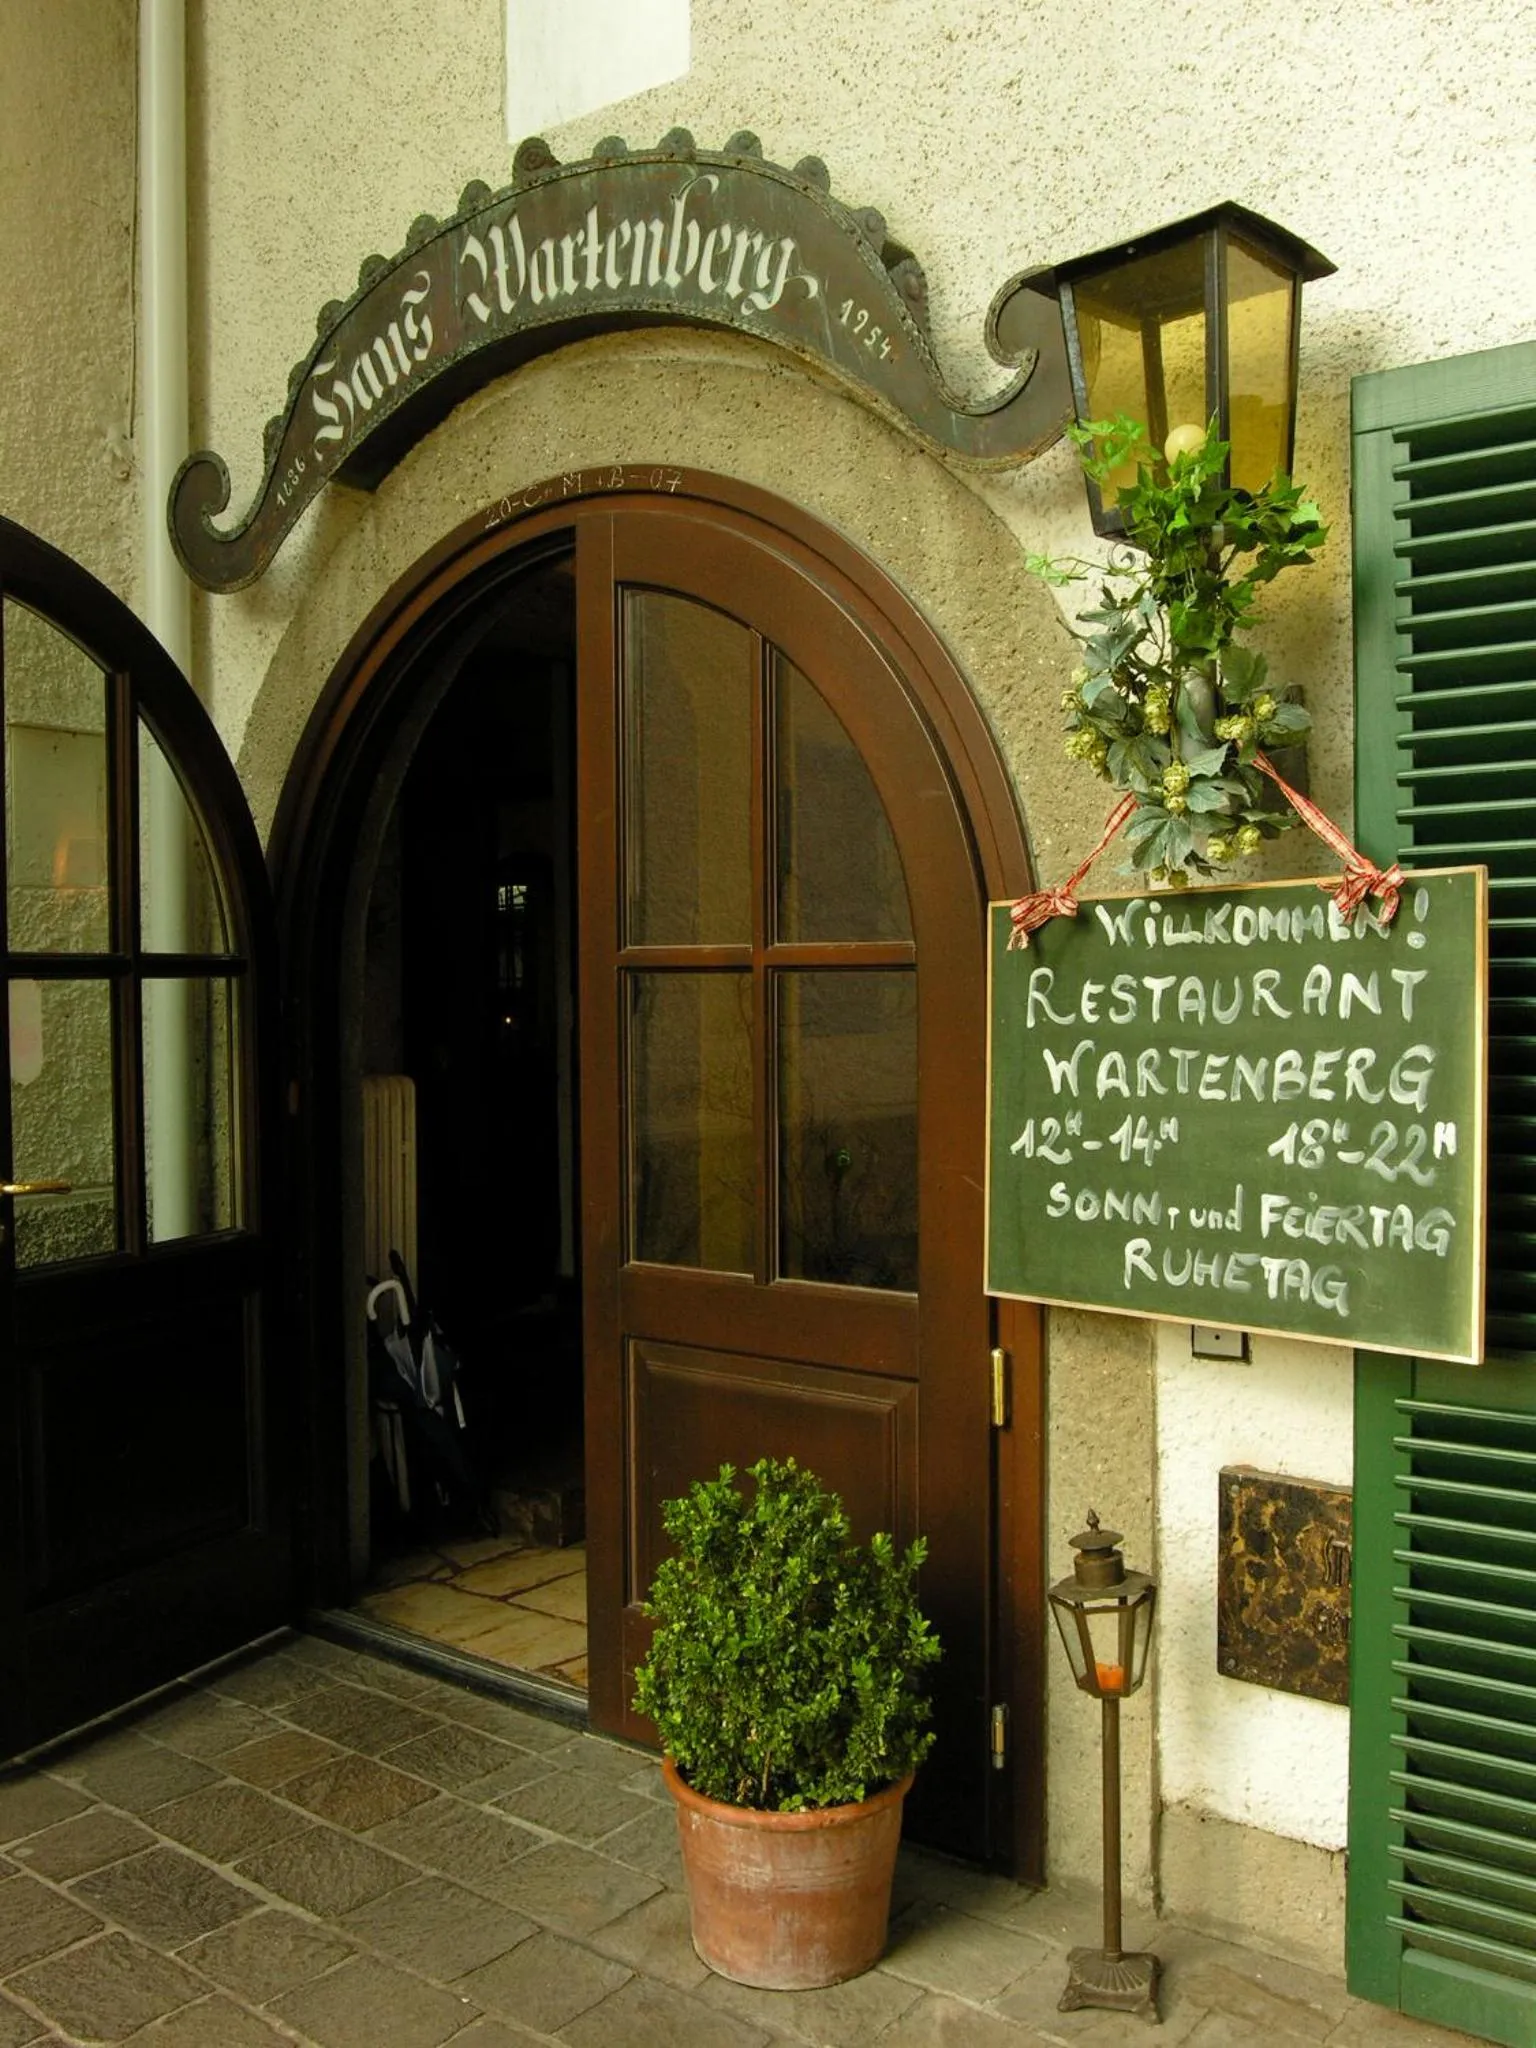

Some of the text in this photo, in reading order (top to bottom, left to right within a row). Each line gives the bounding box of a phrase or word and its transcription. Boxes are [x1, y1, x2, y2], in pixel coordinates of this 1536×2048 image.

[311, 174, 819, 461] Hans Wartenberg
[840, 298, 892, 359] 1954
[1027, 964, 1428, 1028] RESTAURANT
[1043, 1040, 1435, 1113] WARTENBERG
[1189, 1184, 1244, 1232] und
[1123, 1238, 1349, 1316] RUHETAG
